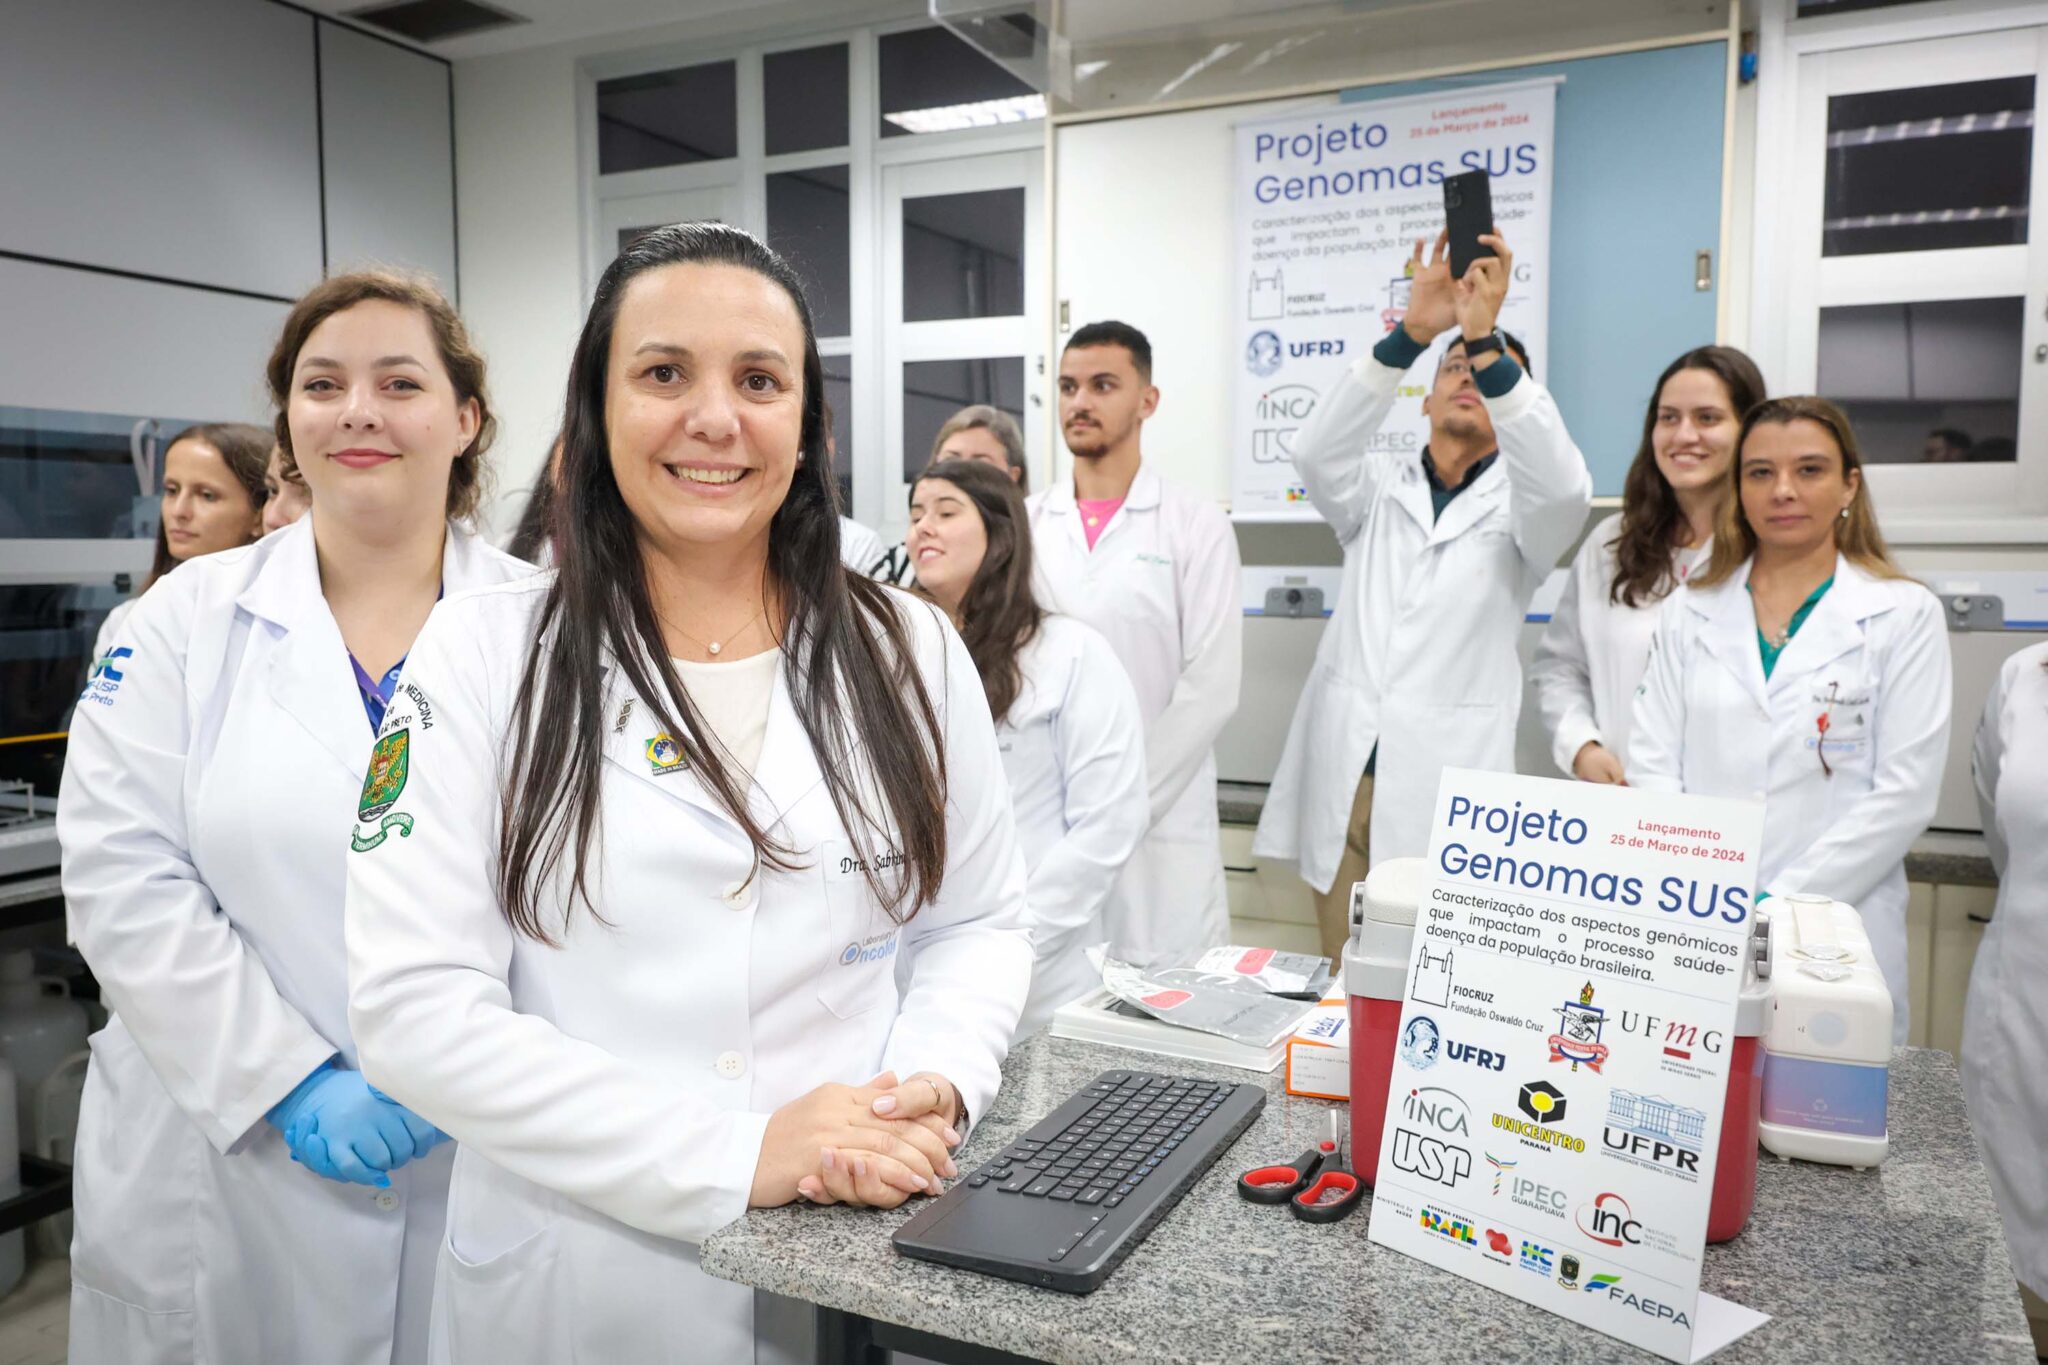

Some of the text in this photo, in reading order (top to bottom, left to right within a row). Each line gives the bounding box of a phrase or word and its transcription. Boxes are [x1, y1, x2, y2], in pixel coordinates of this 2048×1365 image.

[1256, 122, 1387, 166] Projeto
[1255, 144, 1536, 203] Genomas SUS
[1386, 201, 1444, 216] aspecto
[1289, 340, 1344, 358] UFRJ
[391, 715, 412, 730] PRETO
[404, 684, 433, 730] MEDICINA
[1448, 796, 1588, 847] Projeto
[1638, 819, 1721, 841] Lançamento
[1610, 834, 1745, 863] 25 de Março de 2024
[1440, 843, 1749, 924] Genomas SUS
[1429, 907, 1735, 976] que impactam o processo saúde-
[1432, 888, 1738, 957] Caracterização dos aspectos genômicos
[1426, 923, 1655, 982] doença da população brasileira.
[1453, 985, 1494, 1003] FIOCRUZ
[1450, 1001, 1544, 1033] Fundação Oswaldo Cruz
[1447, 1040, 1506, 1072] UFRJ
[1492, 1113, 1586, 1153] UNICENTRO
[1520, 1138, 1551, 1153] PARANÁ
[1603, 1127, 1699, 1173] UFPR
[1392, 1127, 1471, 1188] USP
[1511, 1195, 1566, 1219] GUARAPUAVA
[1512, 1177, 1567, 1210] IPEC
[1420, 1208, 1477, 1246] BRASIL
[1521, 1240, 1554, 1267] HC
[1609, 1286, 1691, 1330] FAEPA
